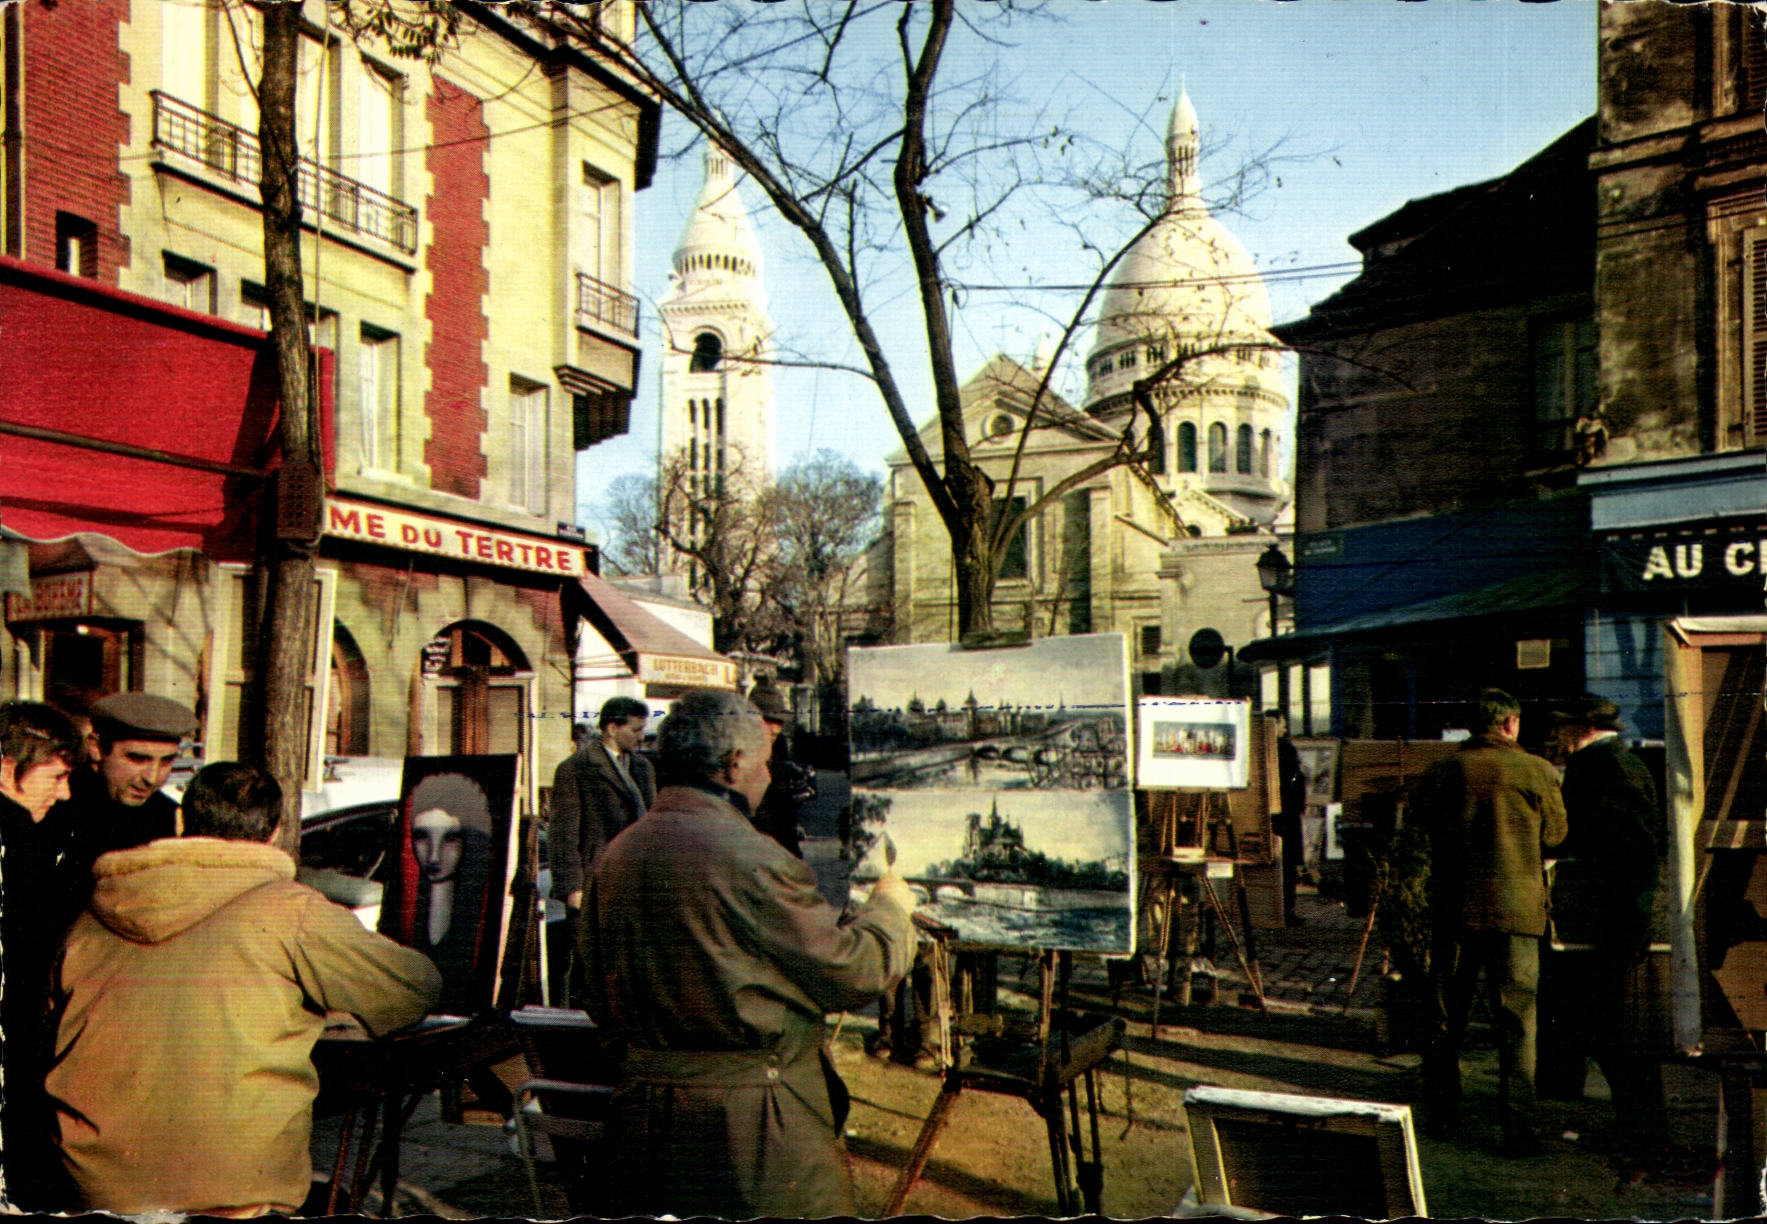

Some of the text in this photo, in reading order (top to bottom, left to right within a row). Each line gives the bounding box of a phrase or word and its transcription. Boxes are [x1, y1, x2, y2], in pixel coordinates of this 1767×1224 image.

[401, 523, 443, 548] DU
[455, 530, 573, 571] TERTRE
[1642, 543, 1703, 580] AU
